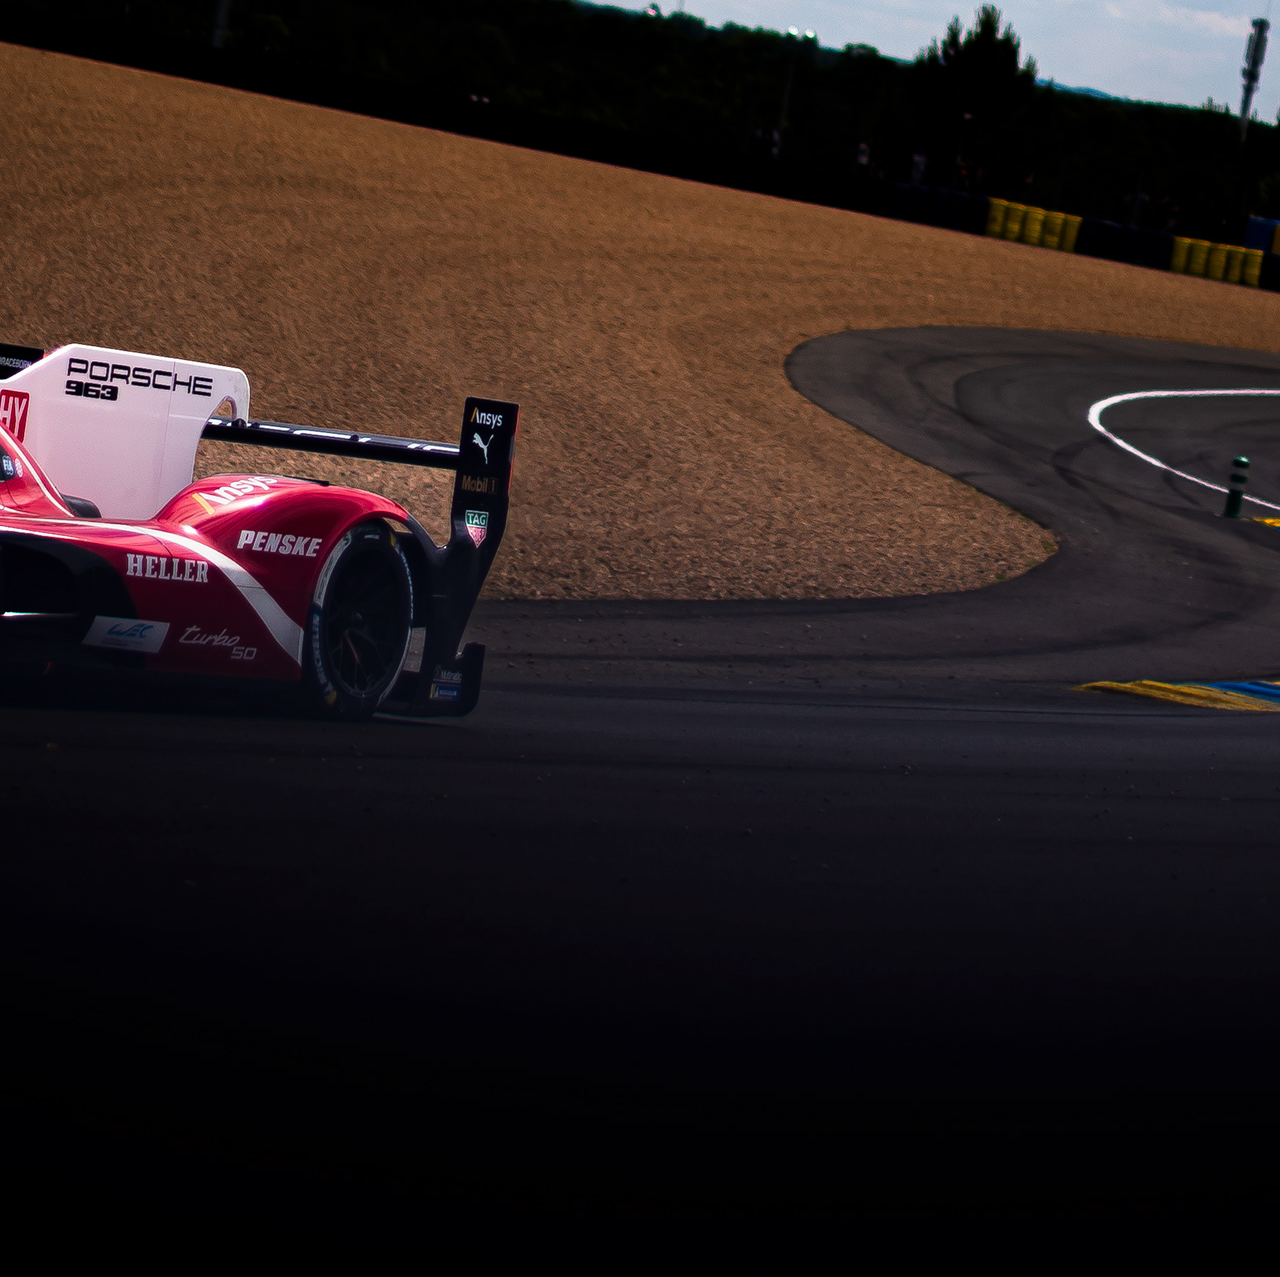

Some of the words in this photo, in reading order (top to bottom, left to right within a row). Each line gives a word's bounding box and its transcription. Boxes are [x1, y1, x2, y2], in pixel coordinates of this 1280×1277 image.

[66, 358, 213, 397] PORSCHE
[65, 380, 119, 401] 963
[0, 394, 29, 438] HY
[470, 406, 504, 430] Ansys
[191, 475, 280, 516] Ansys
[461, 474, 489, 494] Mobil
[467, 512, 487, 526] TAG
[237, 529, 323, 558] PENSKE
[126, 553, 209, 583] HELLER
[178, 625, 241, 648] turbo
[230, 646, 258, 661] 50
